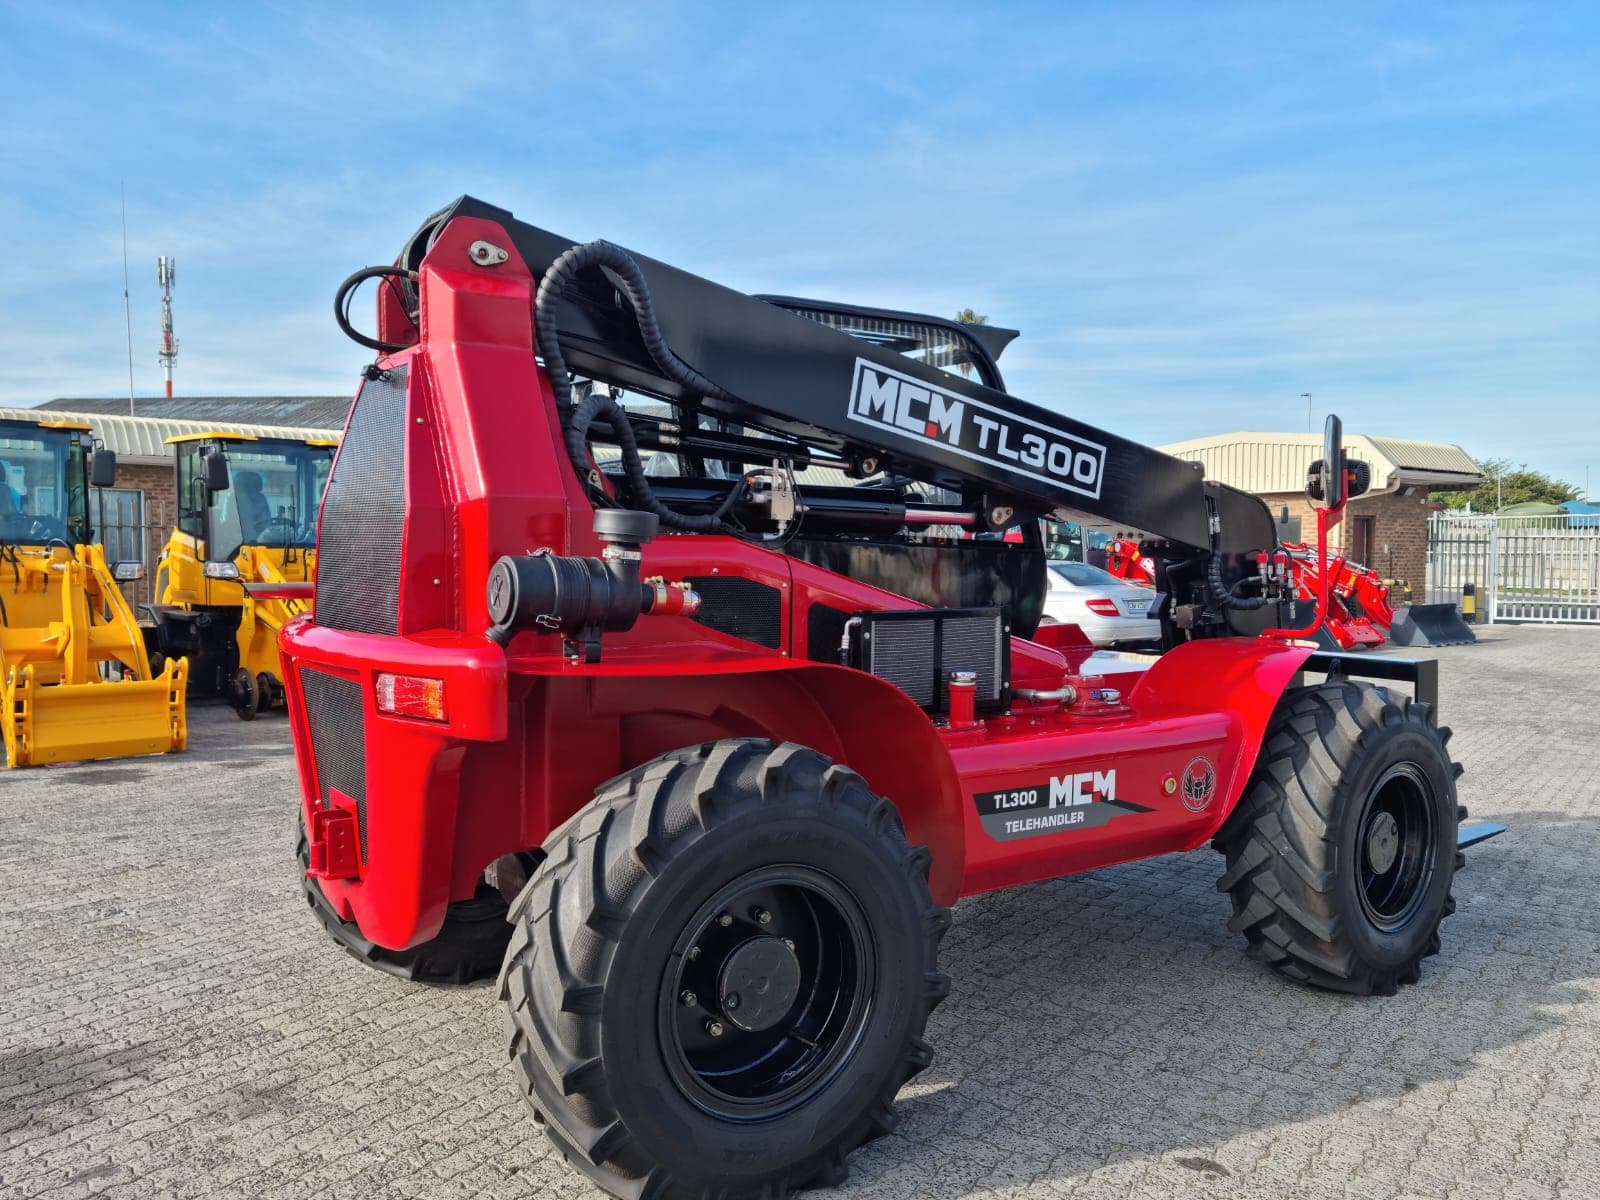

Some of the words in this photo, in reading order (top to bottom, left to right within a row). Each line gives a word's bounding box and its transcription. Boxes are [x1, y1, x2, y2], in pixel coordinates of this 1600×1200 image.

[857, 368, 965, 446] MCM
[972, 414, 1098, 485] TL300
[993, 790, 1038, 809] TL300
[1048, 769, 1116, 809] MCM
[1004, 811, 1085, 834] TELEHANDLER
